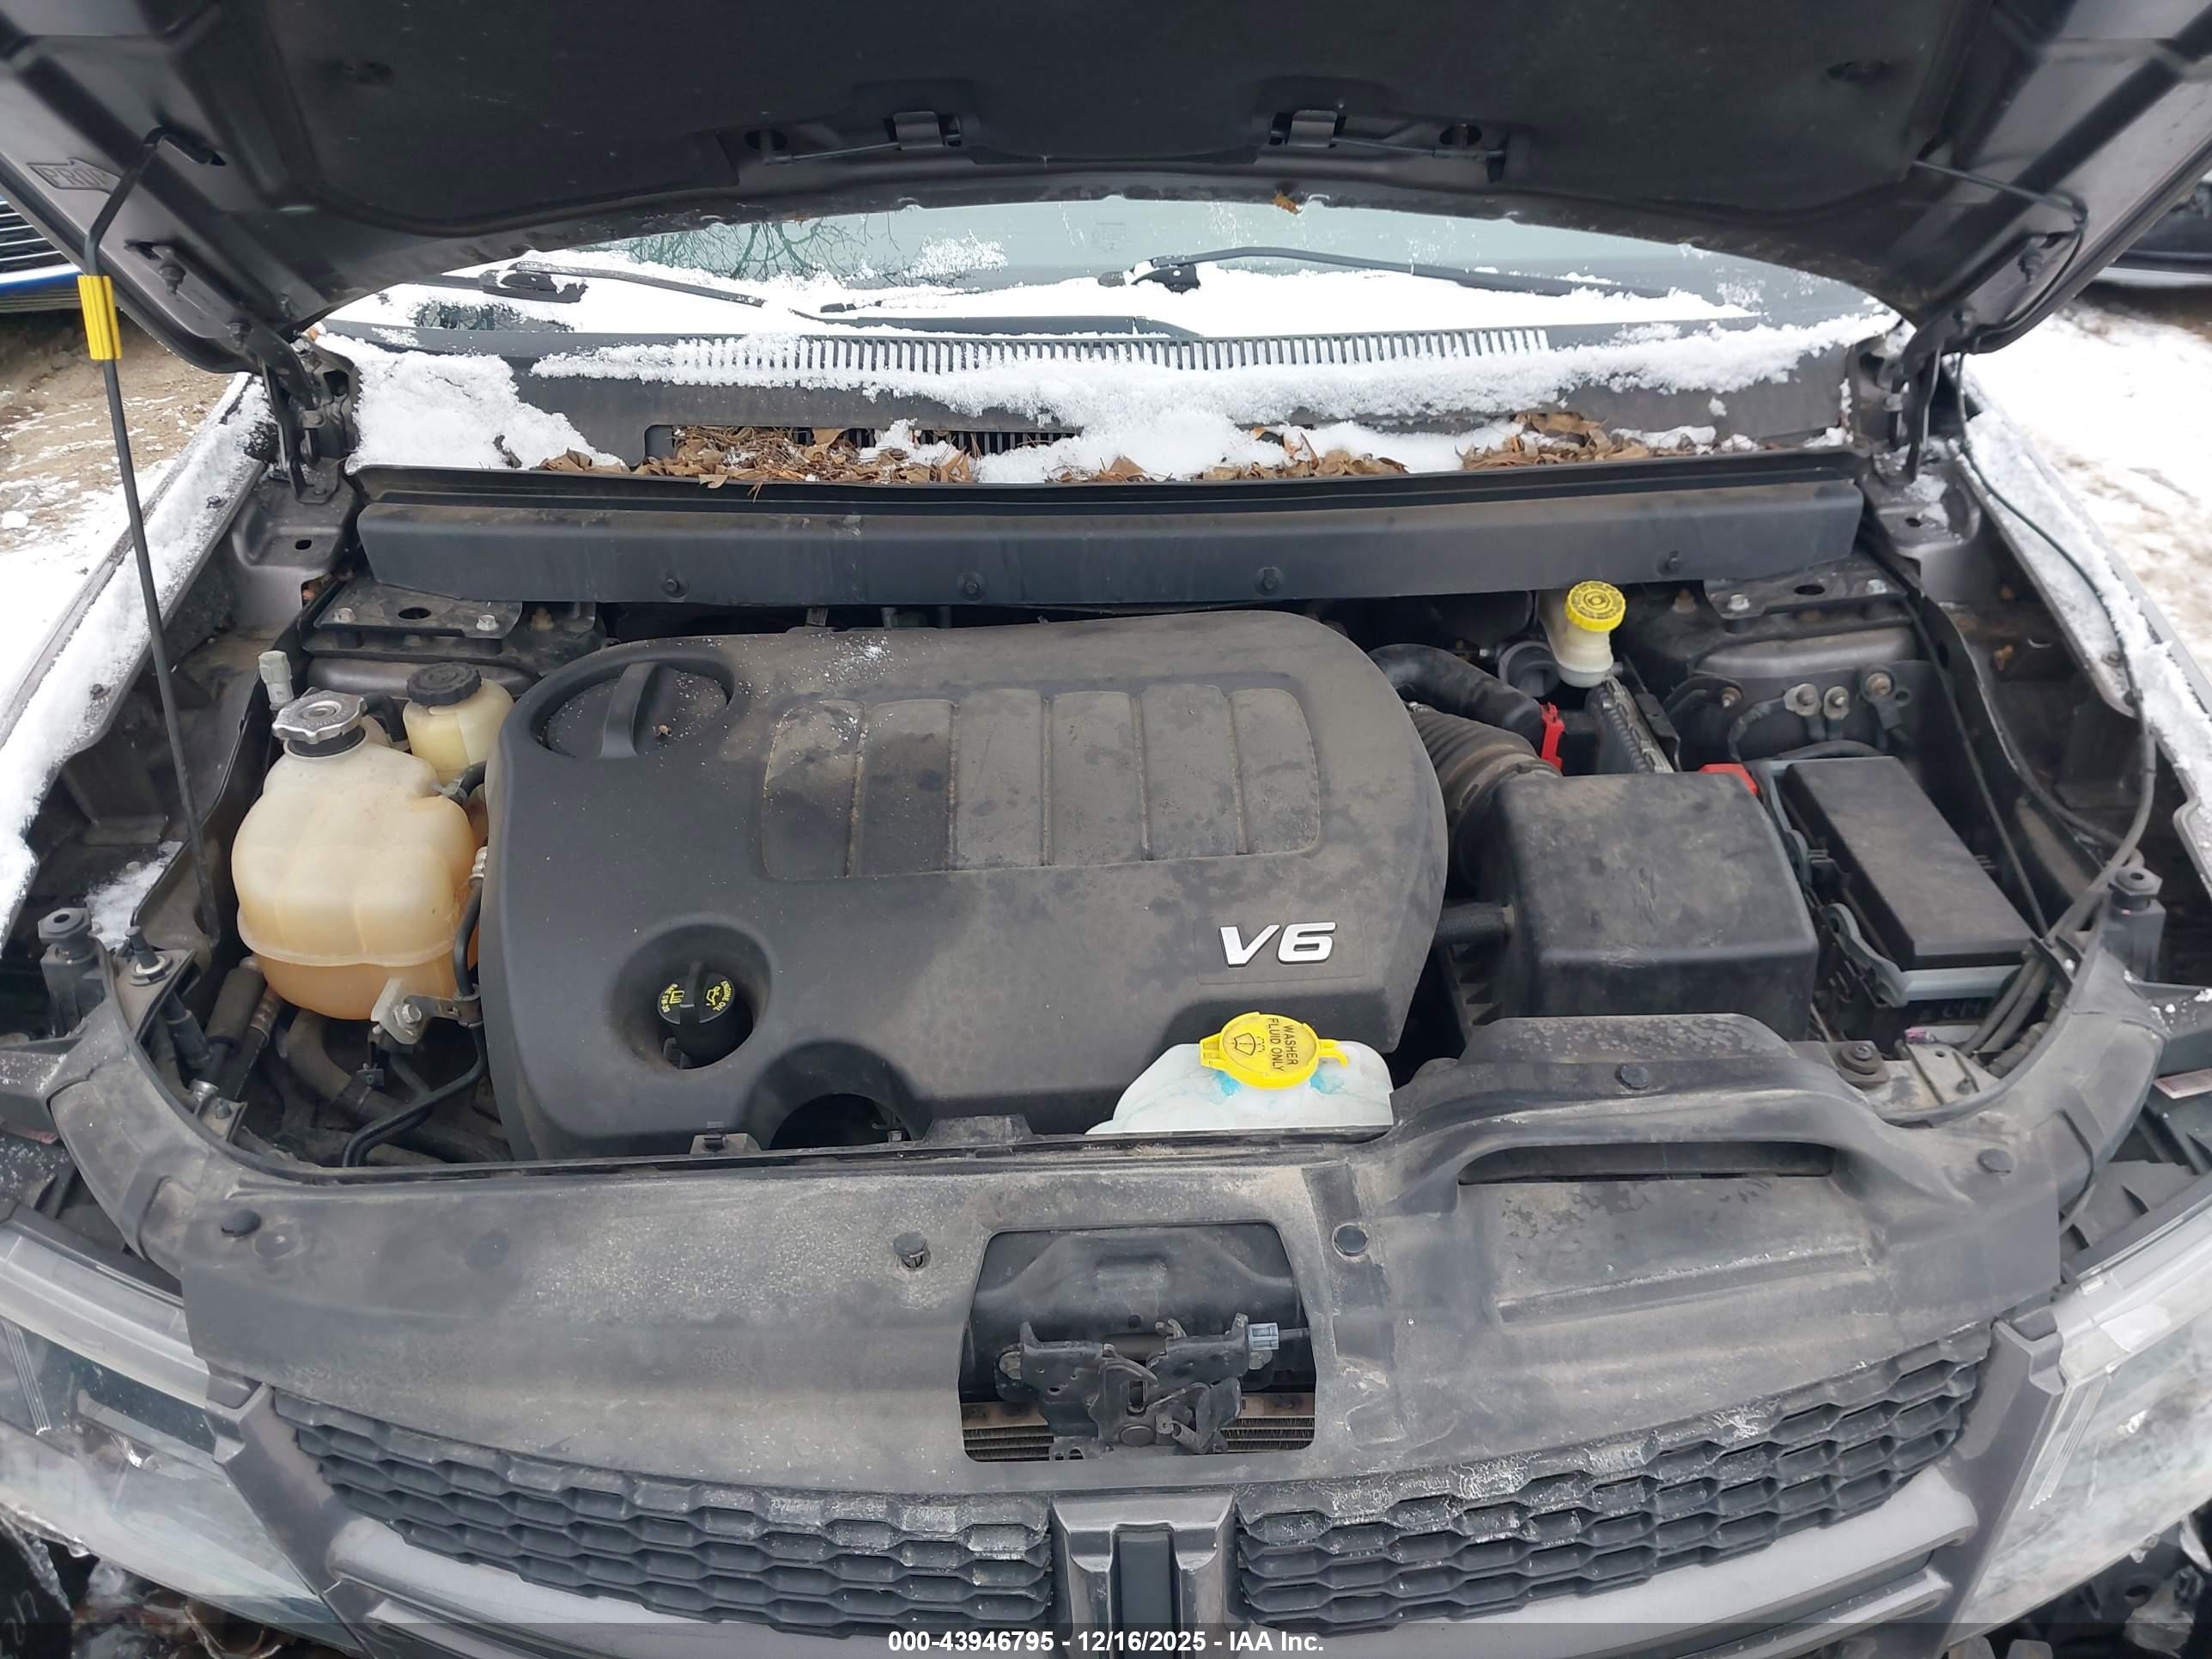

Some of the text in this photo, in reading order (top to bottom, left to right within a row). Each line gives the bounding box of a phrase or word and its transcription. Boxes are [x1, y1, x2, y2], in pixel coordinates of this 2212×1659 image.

[36, 167, 108, 186] PROP
[1218, 921, 1337, 968] V6
[712, 980, 732, 1012] ENGINE OIL
[1267, 1018, 1285, 1072] FLUID ONLY
[1283, 1024, 1298, 1066] WASHER
